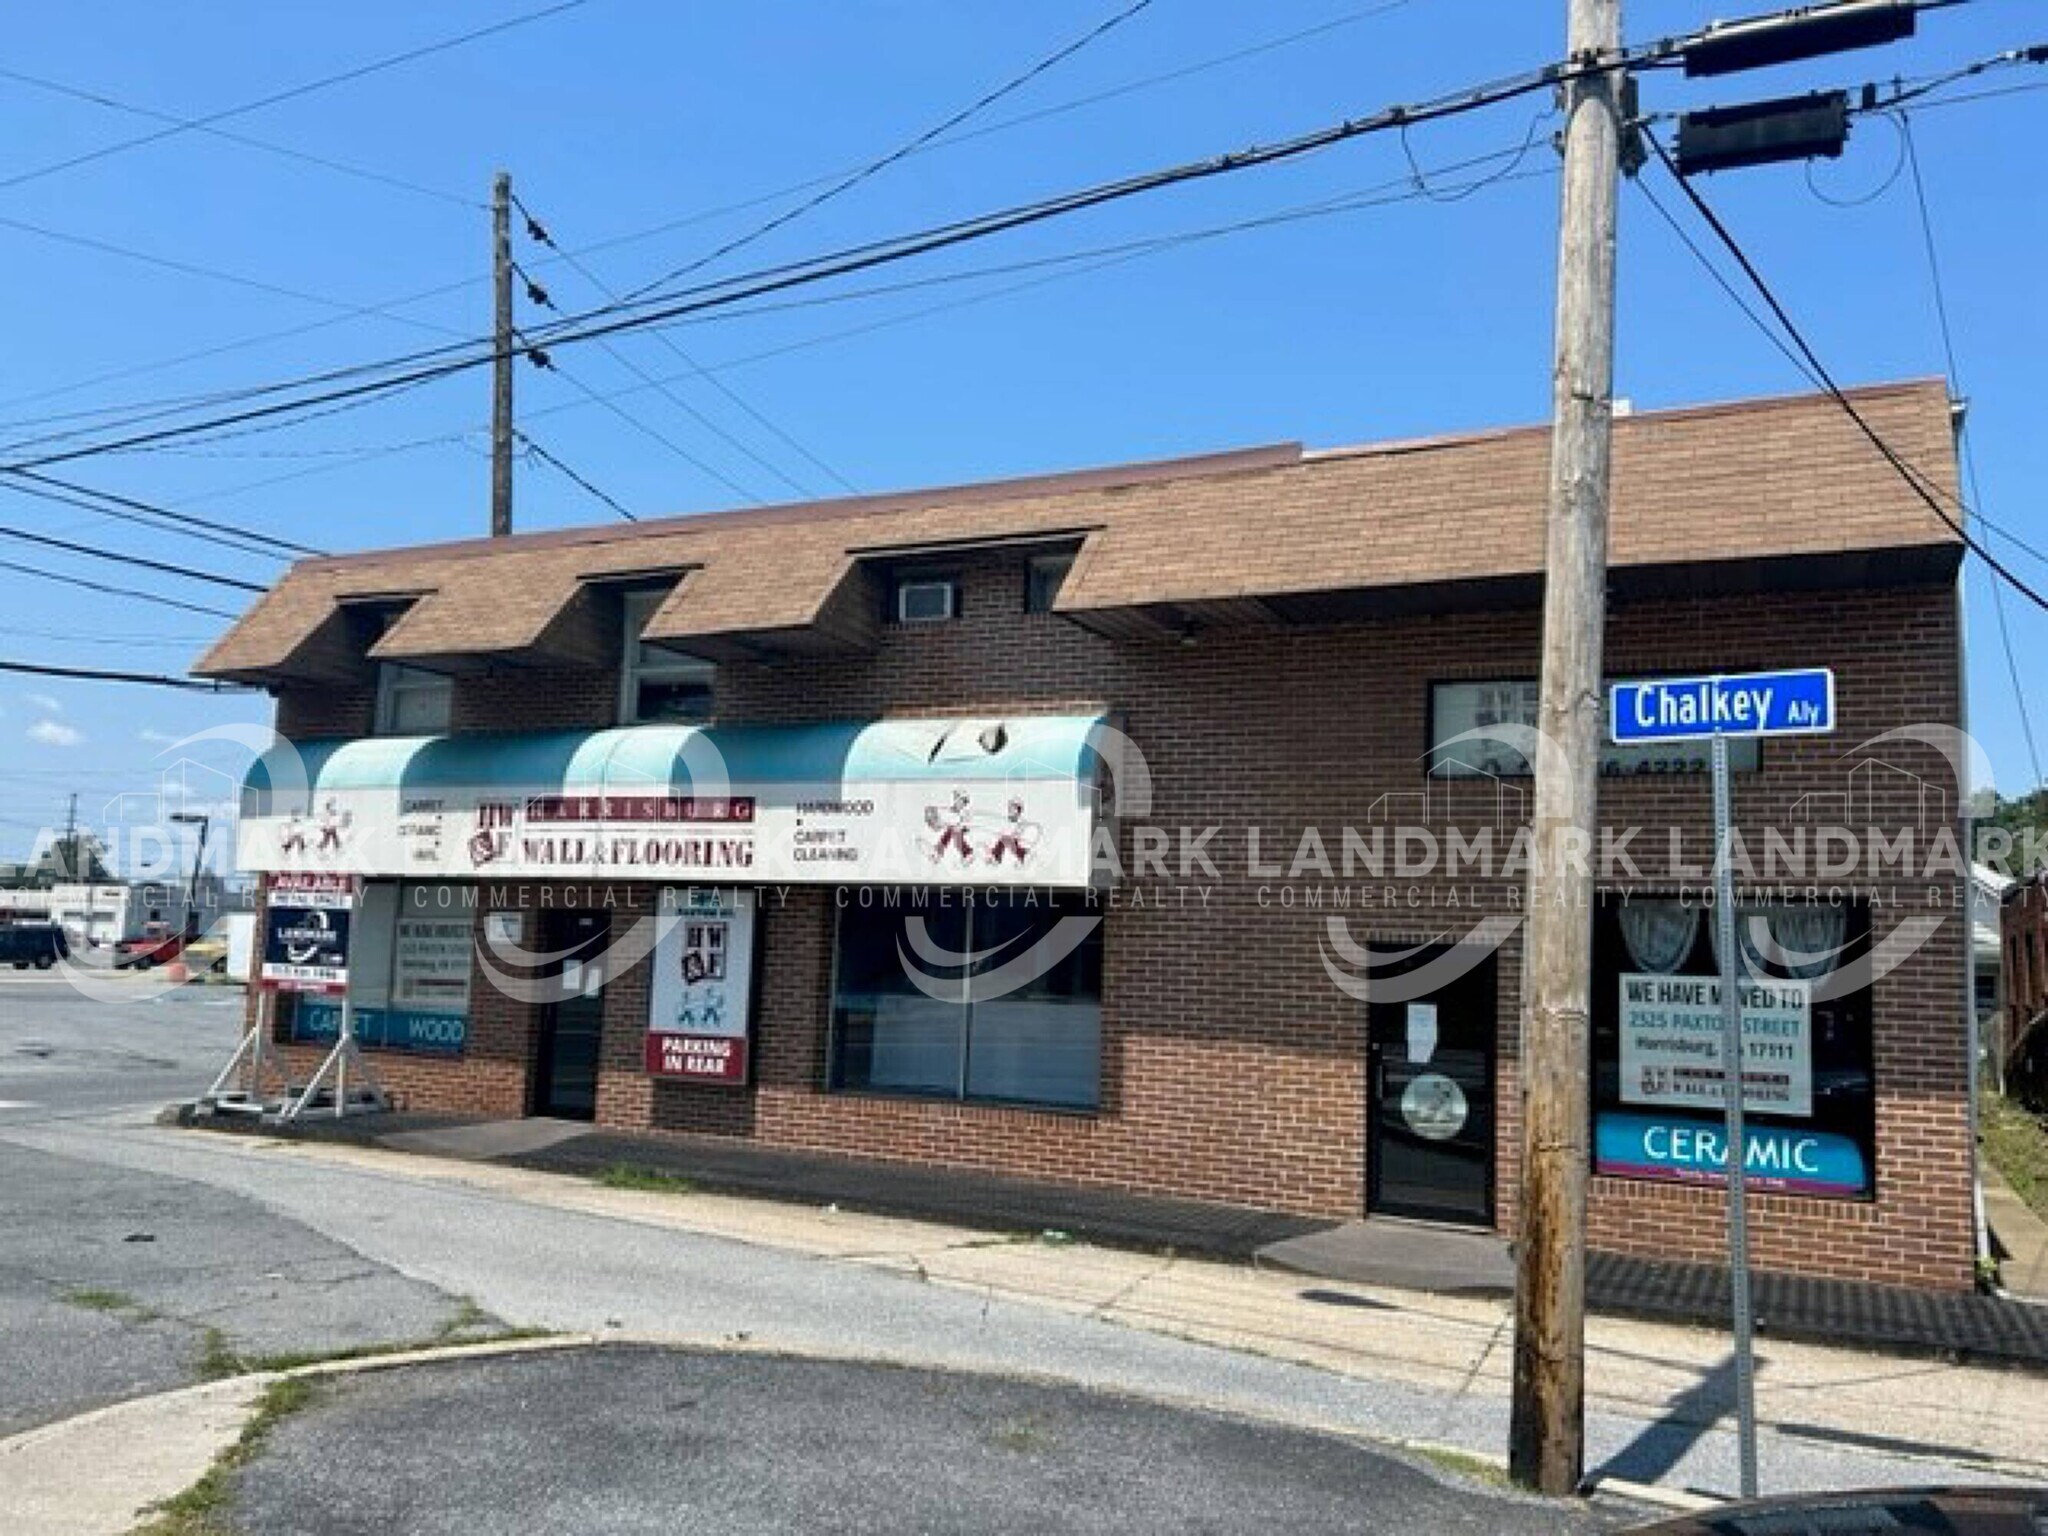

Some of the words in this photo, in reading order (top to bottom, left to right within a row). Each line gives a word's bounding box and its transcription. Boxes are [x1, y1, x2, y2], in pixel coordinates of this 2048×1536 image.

[1636, 683, 1774, 731] Chalkey
[1787, 700, 1821, 728] Aly
[796, 800, 875, 815] HARDWOOD
[523, 837, 586, 865] WALL
[610, 837, 754, 868] FLOORING
[1628, 981, 1656, 1002] WE
[1659, 982, 1707, 1006] HAVE
[1781, 987, 1803, 1010] TO
[408, 1016, 465, 1042] WOOD
[1628, 1010, 1668, 1029] 2525
[1743, 1016, 1801, 1038] STREET
[661, 1036, 731, 1057] PARKING
[1750, 1042, 1794, 1060] 17111
[664, 1055, 682, 1071] IN
[685, 1055, 725, 1073] REAR
[1643, 1125, 1820, 1172] CERMIC
